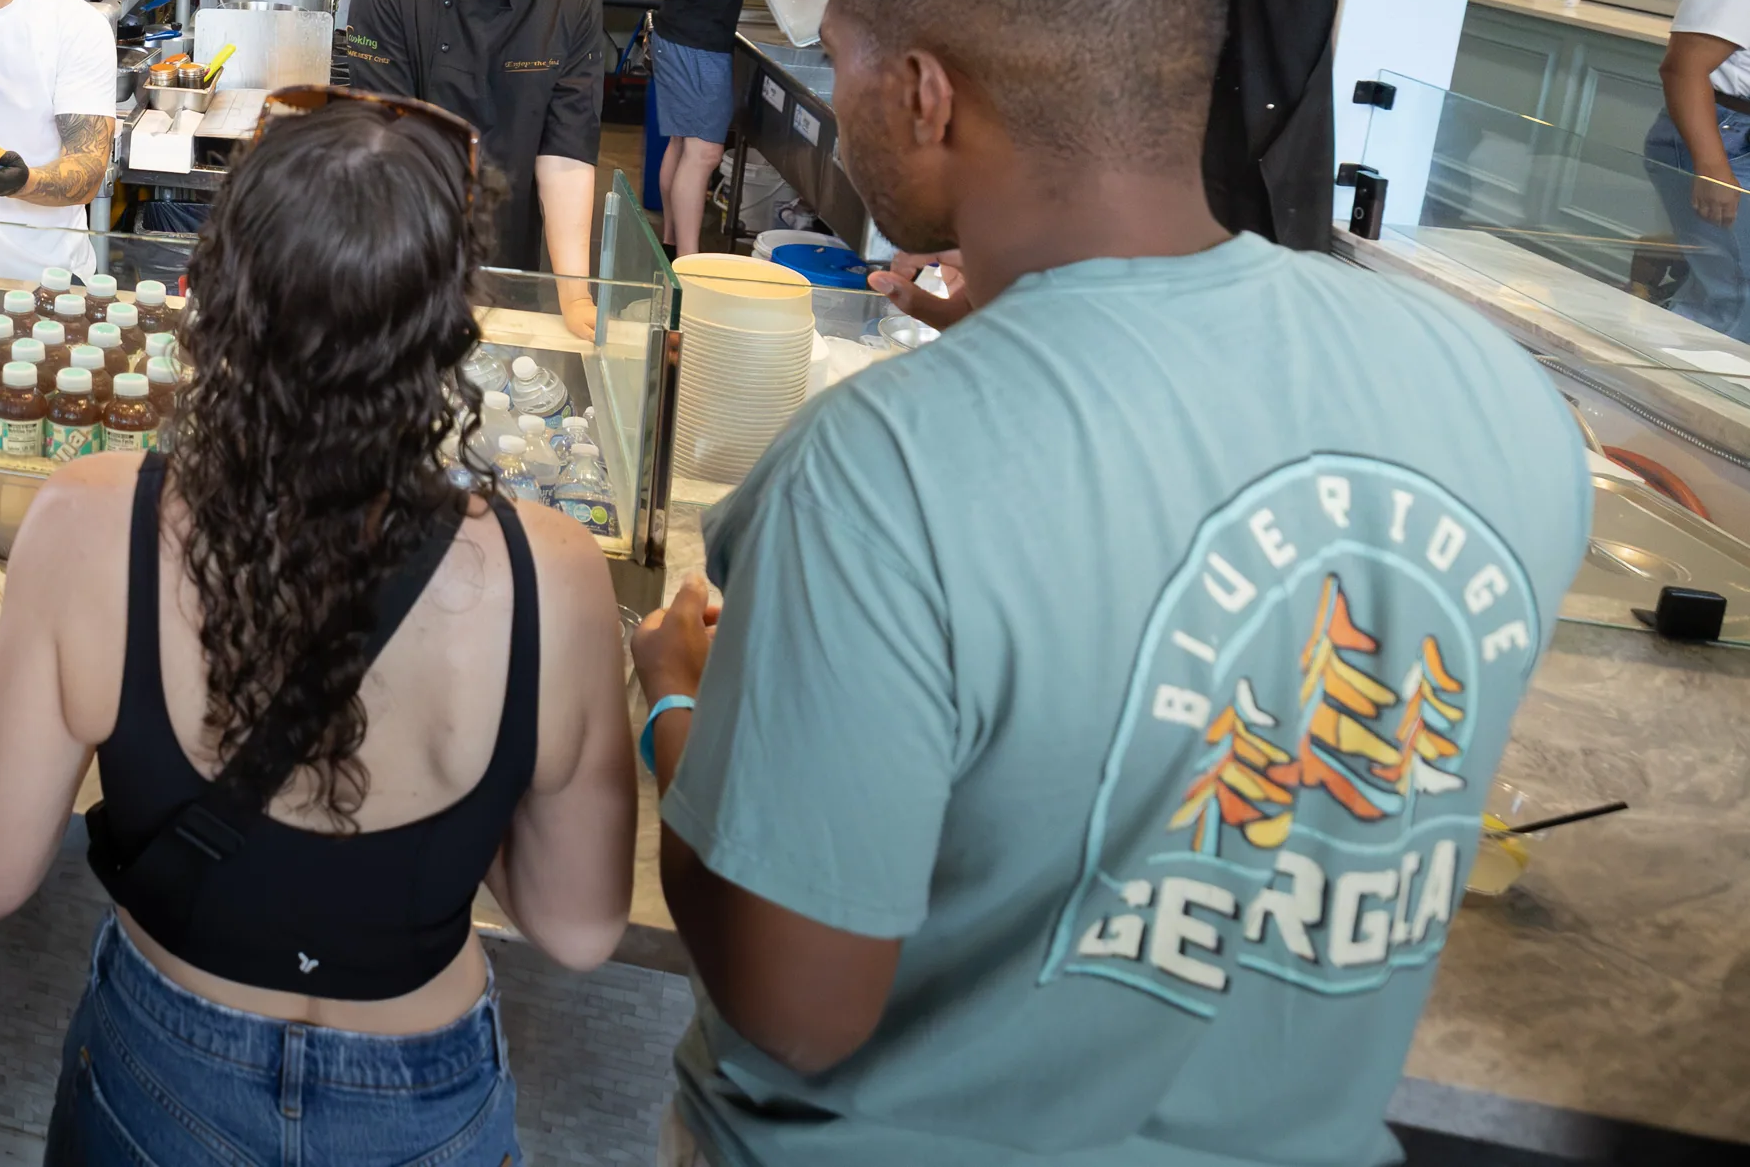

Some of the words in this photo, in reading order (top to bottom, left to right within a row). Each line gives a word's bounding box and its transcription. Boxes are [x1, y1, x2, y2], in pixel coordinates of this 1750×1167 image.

[539, 489, 554, 498] ure
[1316, 475, 1530, 663] RIDGE
[1077, 839, 1457, 992] GERGIA
